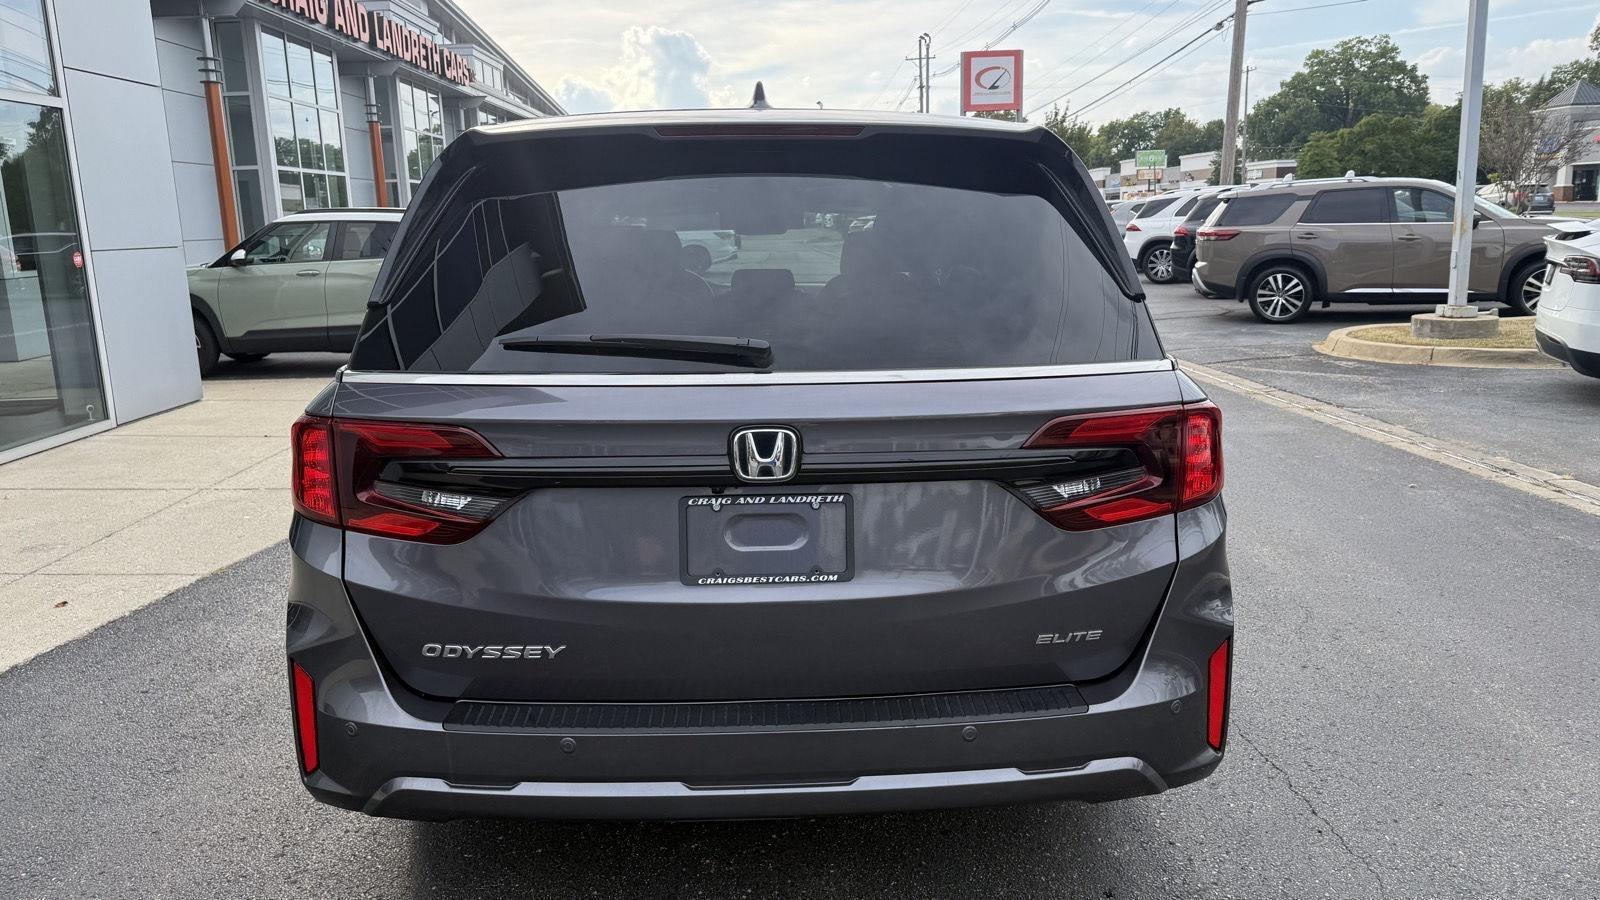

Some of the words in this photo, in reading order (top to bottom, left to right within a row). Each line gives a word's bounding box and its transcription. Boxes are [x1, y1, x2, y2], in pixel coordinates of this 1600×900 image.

[334, 0, 370, 43] AND
[374, 11, 441, 75] LANDRETH
[443, 48, 470, 86] CARS
[688, 497, 731, 506] CRAIG
[735, 496, 765, 505] AND
[769, 495, 844, 504] LANDRETH
[698, 575, 838, 585] CRAIGSBESTCARS.COM
[1036, 630, 1103, 645] ELITE
[421, 643, 567, 659] ODYSSEY
